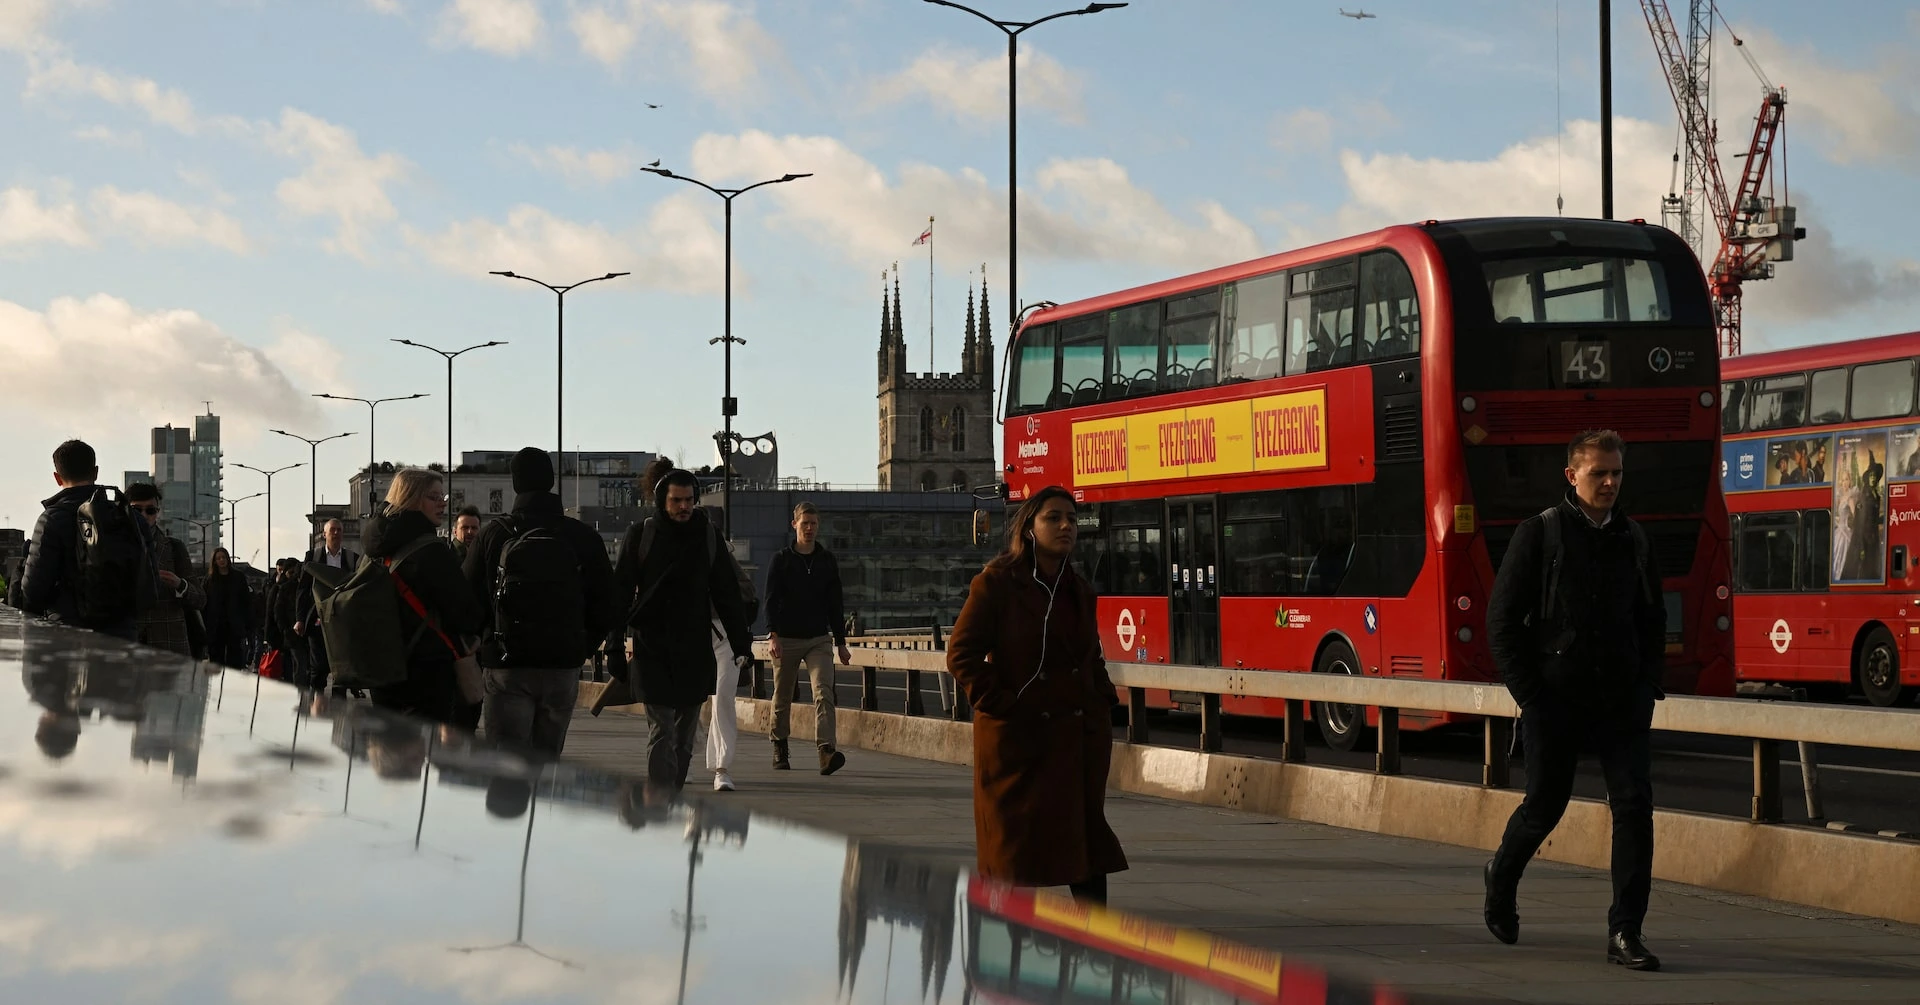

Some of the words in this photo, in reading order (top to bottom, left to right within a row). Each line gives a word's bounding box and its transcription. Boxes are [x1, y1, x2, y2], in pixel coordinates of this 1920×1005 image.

[1567, 346, 1605, 380] 43
[1018, 438, 1049, 458] Metroline
[1159, 417, 1217, 468] EYEZEGGING
[1254, 404, 1320, 458] EYEZEGGING
[1076, 428, 1127, 475] EYEZEGGING
[1740, 453, 1754, 464] prime
[1740, 463, 1753, 472] video
